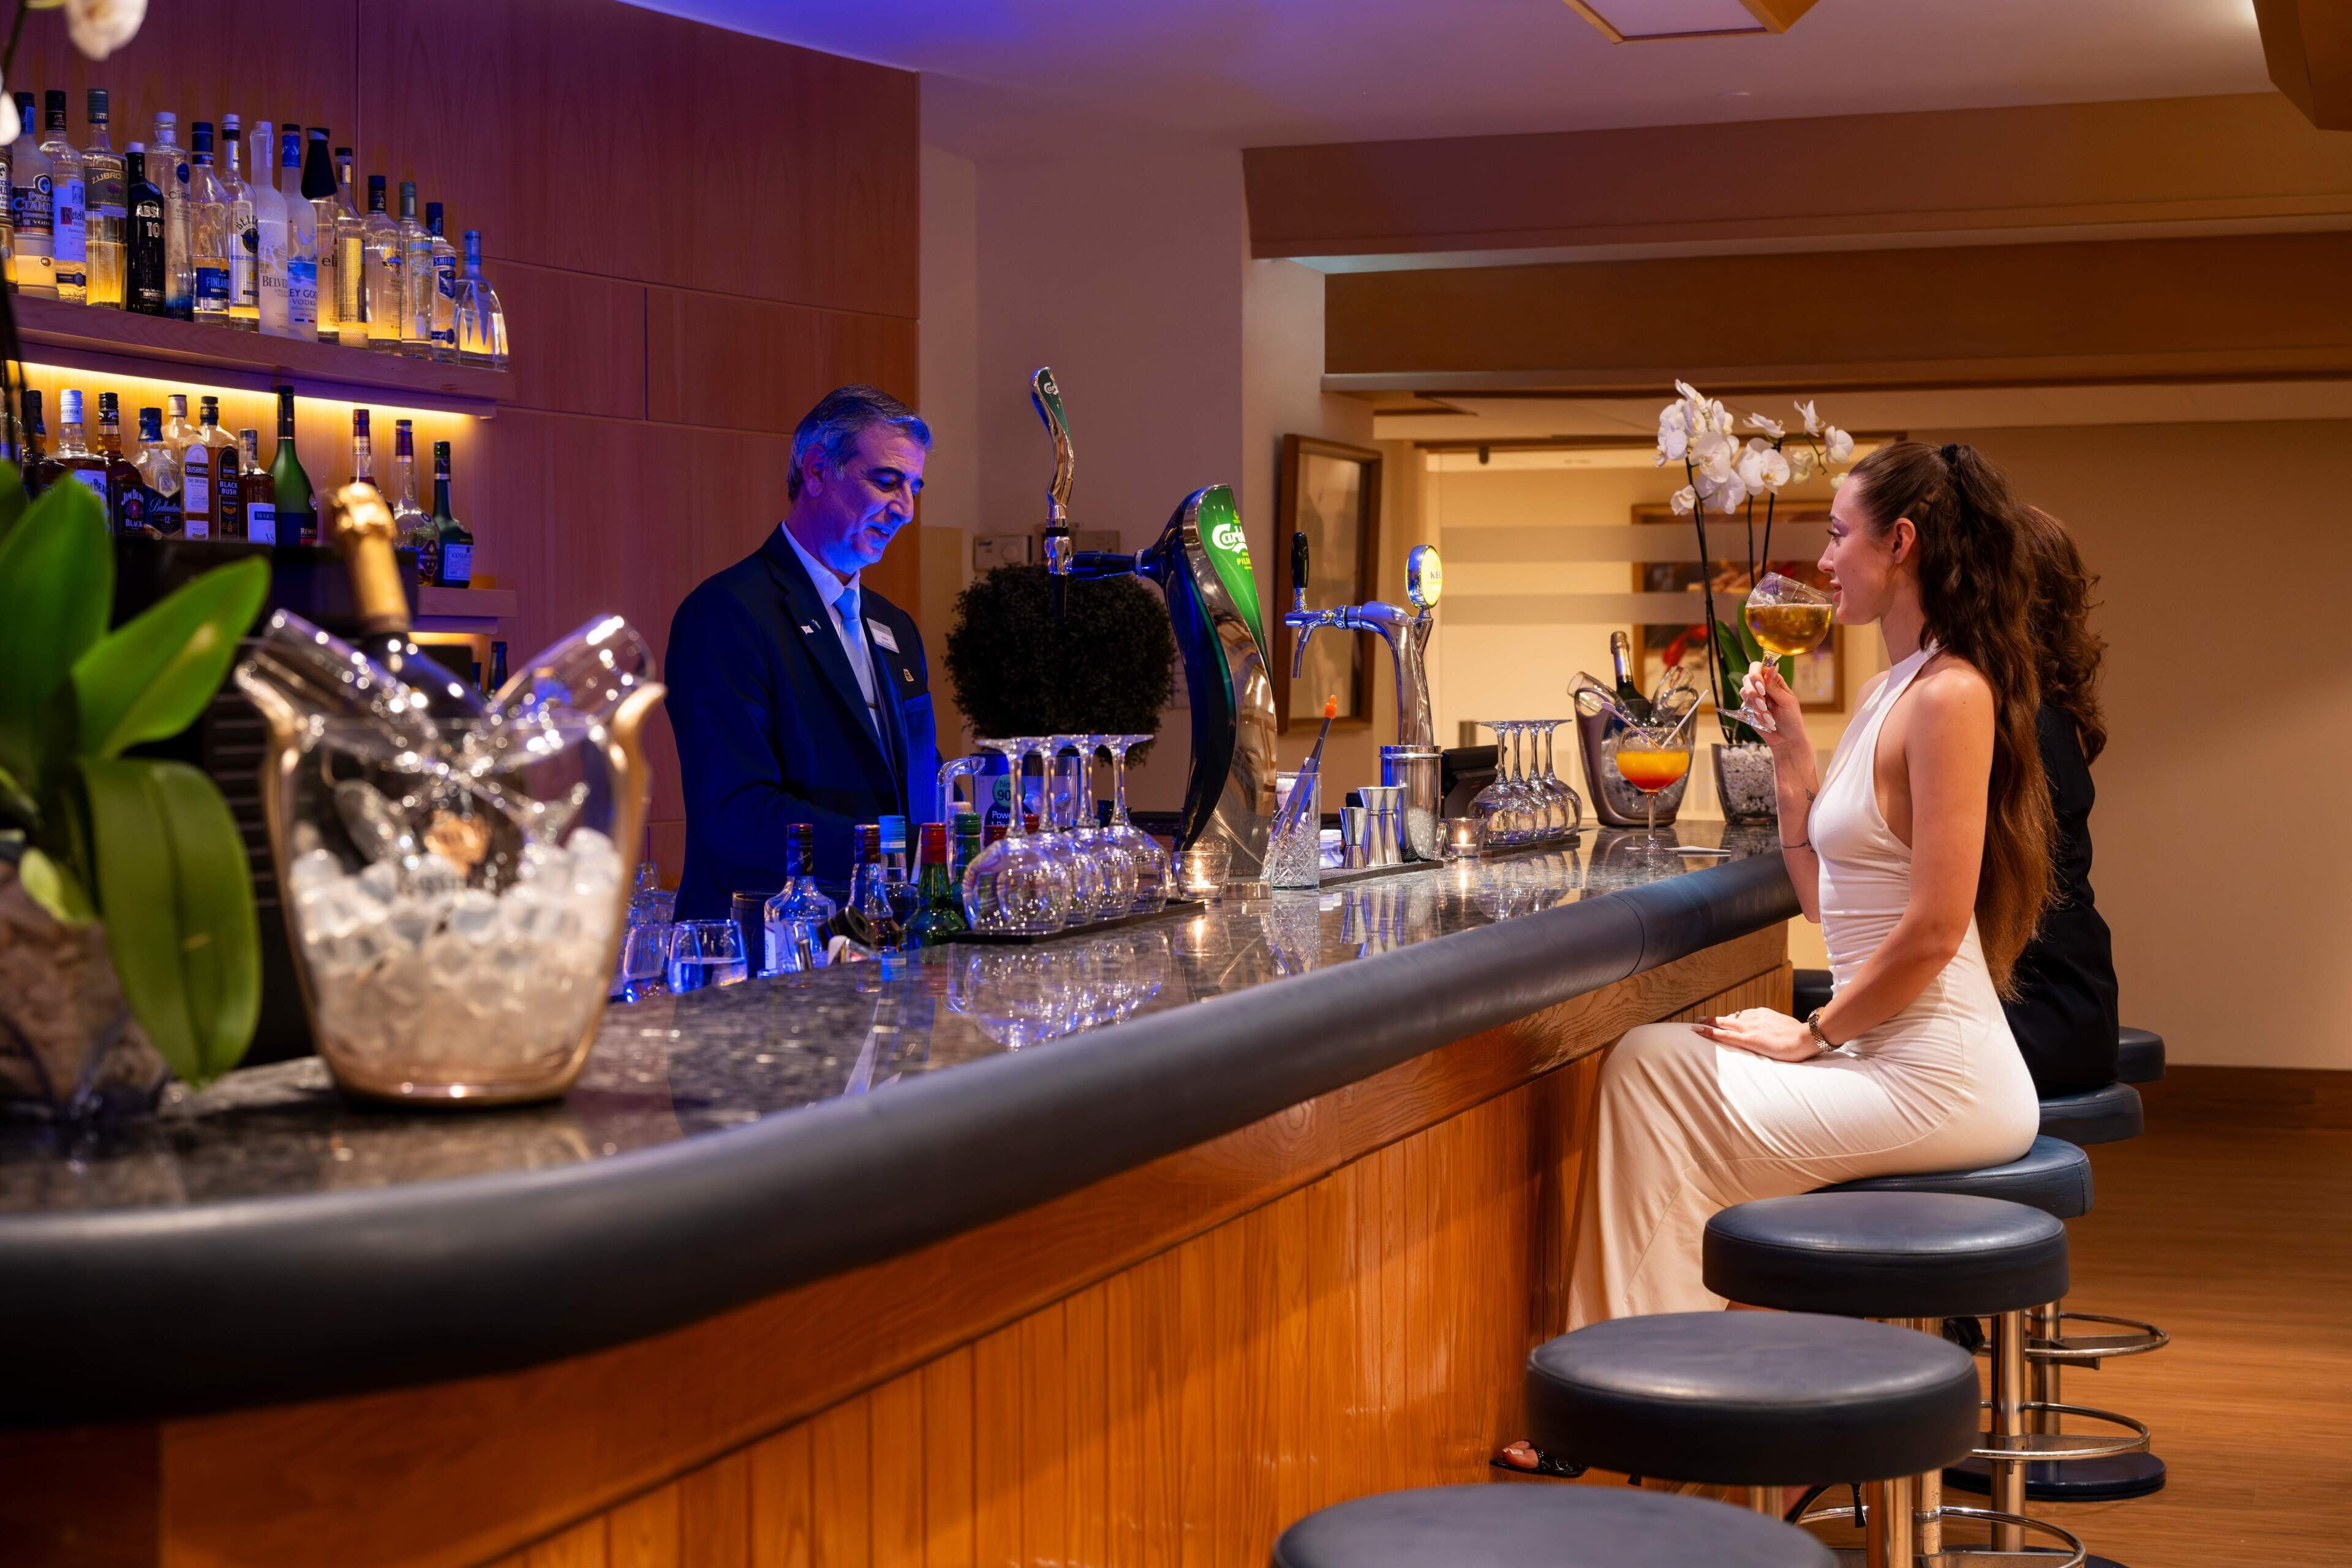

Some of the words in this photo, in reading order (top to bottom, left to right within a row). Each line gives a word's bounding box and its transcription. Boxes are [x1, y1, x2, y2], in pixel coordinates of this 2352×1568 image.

[121, 491, 132, 506] JIM
[125, 519, 143, 528] BLACK
[164, 516, 171, 524] 12
